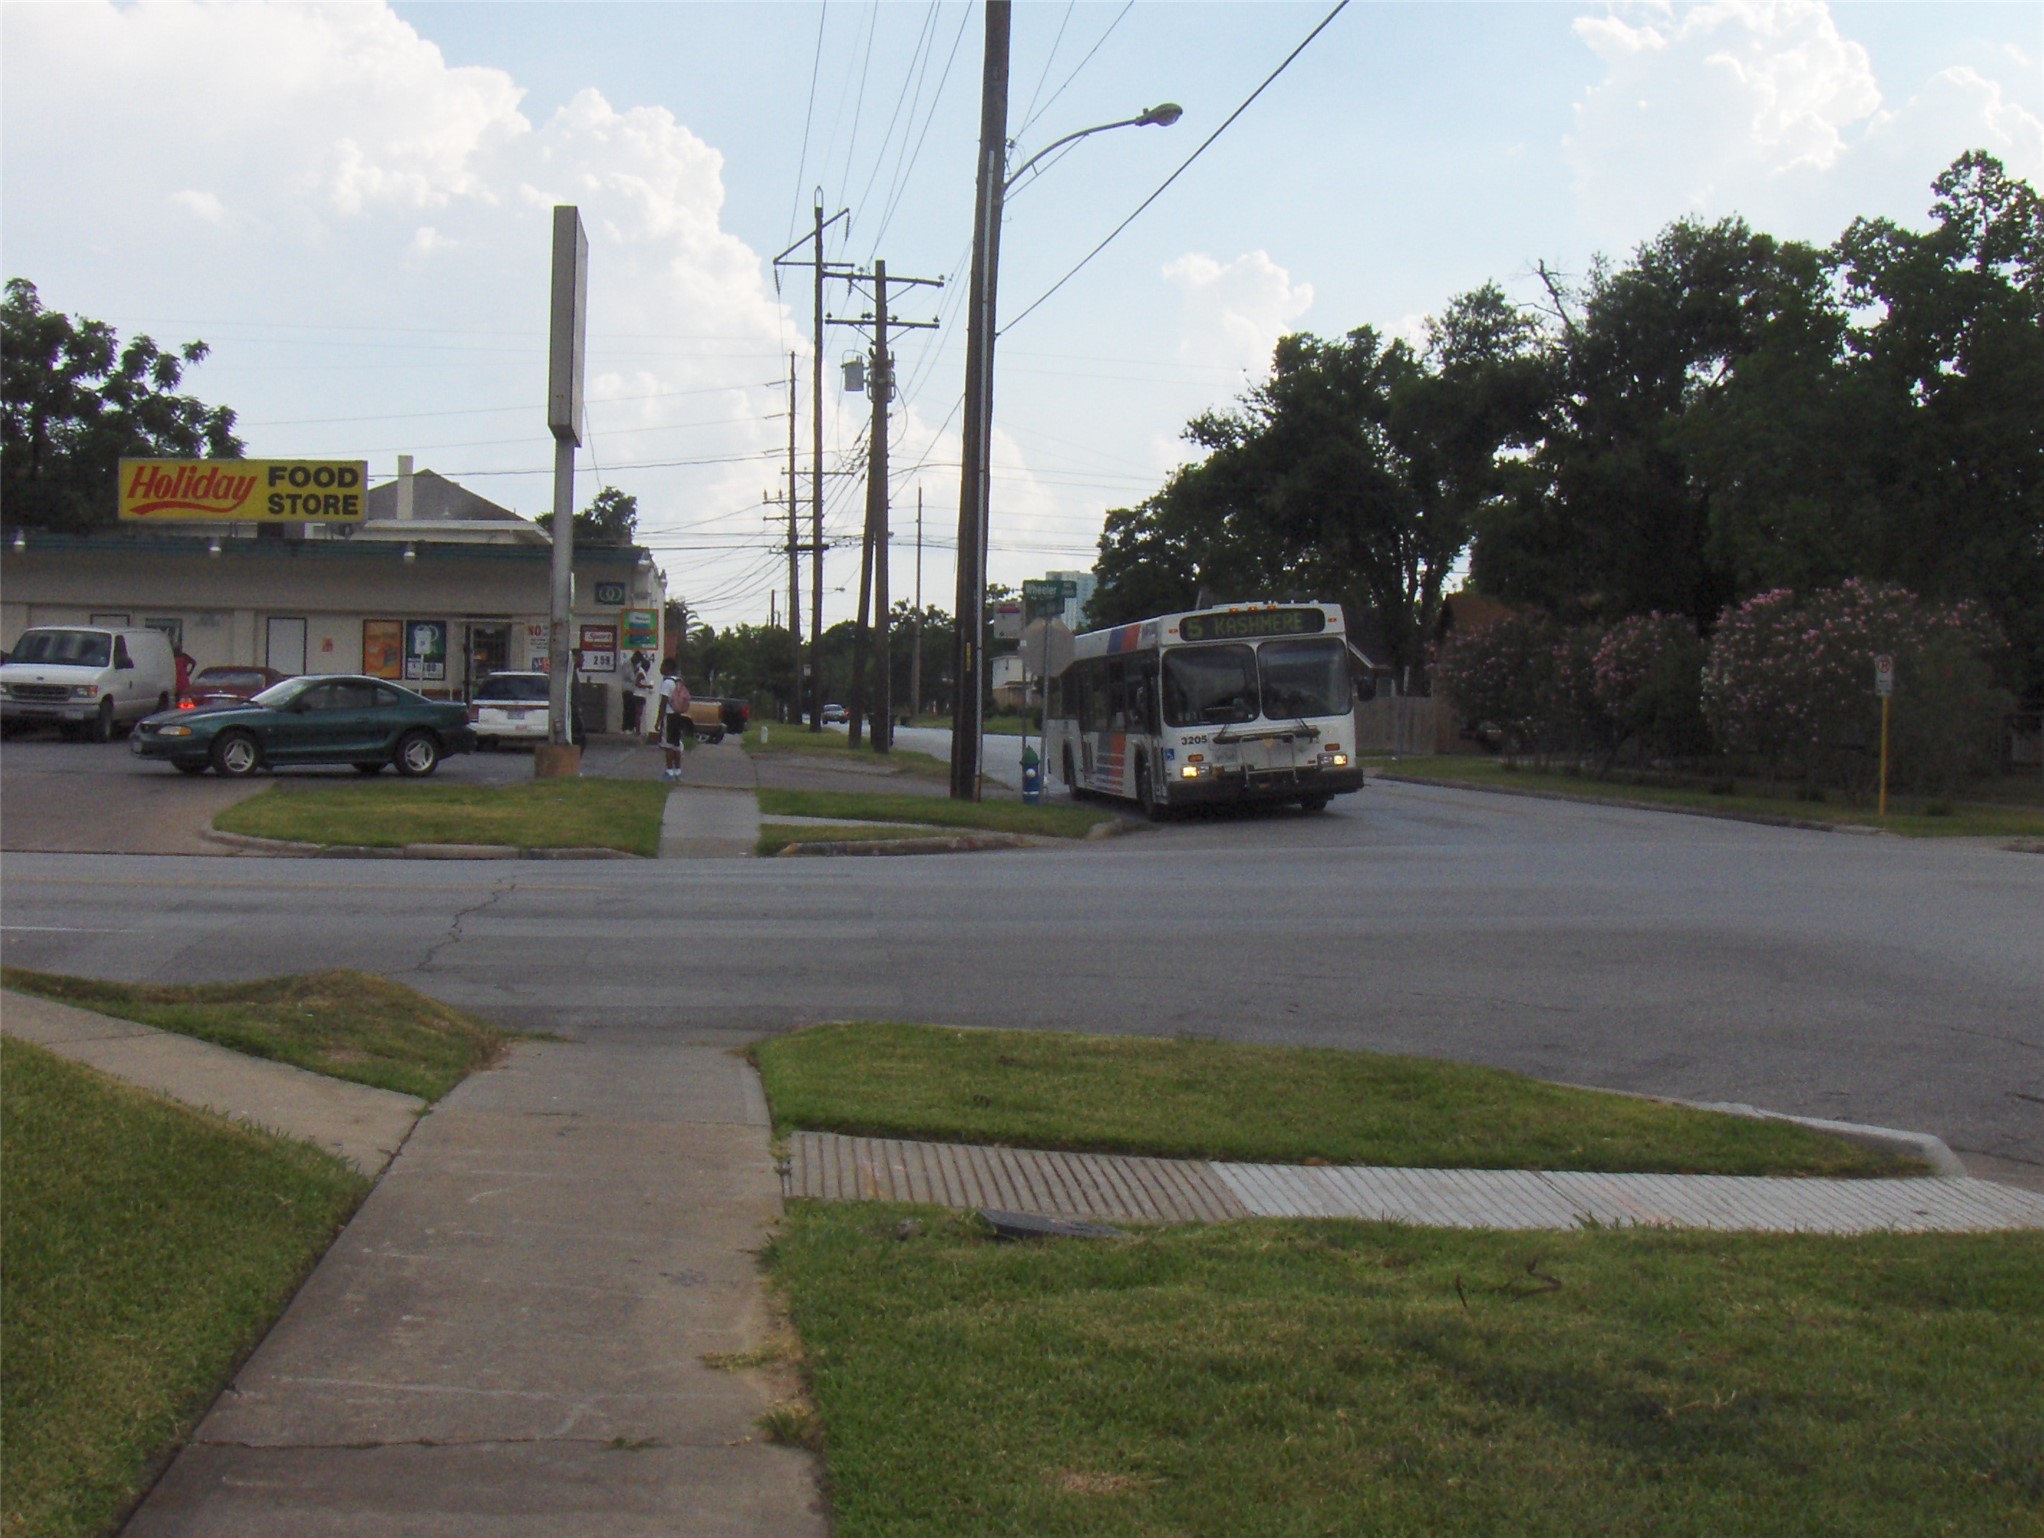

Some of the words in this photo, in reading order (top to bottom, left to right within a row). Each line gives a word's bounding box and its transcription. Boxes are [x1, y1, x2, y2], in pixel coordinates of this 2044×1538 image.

[268, 466, 359, 488] FOOD
[127, 466, 257, 514] Holiday
[268, 493, 359, 515] STORE
[1214, 612, 1303, 637] KASHMERE
[1181, 735, 1208, 746] 3205
